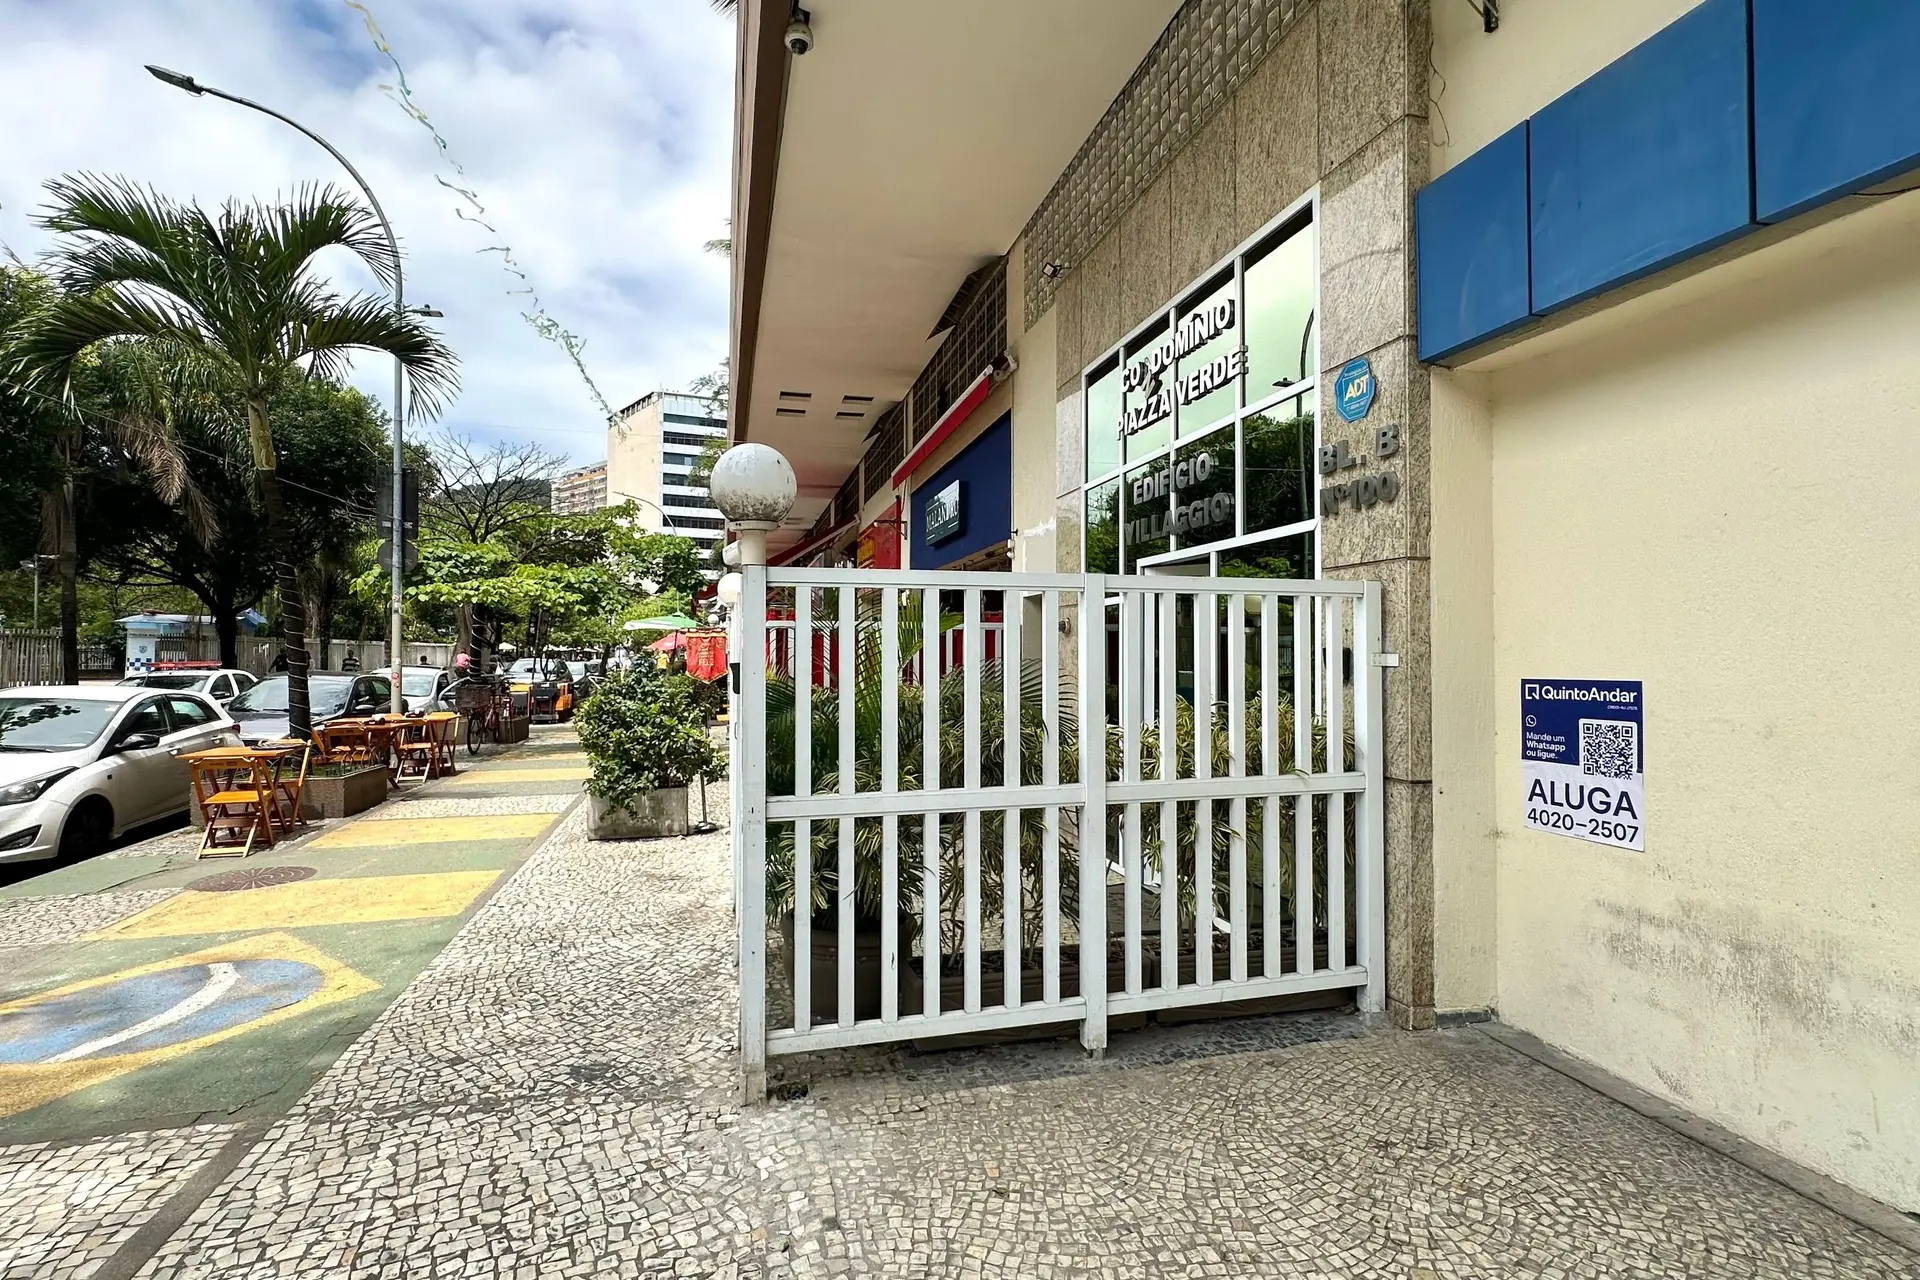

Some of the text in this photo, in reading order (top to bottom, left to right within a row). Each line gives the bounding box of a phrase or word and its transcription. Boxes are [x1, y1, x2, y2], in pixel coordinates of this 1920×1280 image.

[1117, 345, 1247, 440] PIAZZA VERDE
[1344, 374, 1369, 402] ADT
[1376, 425, 1399, 457] B
[1124, 492, 1232, 546] VILLAGGIO
[1541, 686, 1637, 703] QuintoAndar
[1526, 732, 1552, 741] Mande
[1526, 740, 1566, 752] Whatsapp
[1537, 750, 1558, 759] ligue.
[1527, 778, 1638, 820] ALUGA
[1527, 808, 1639, 843] 4020-2507
